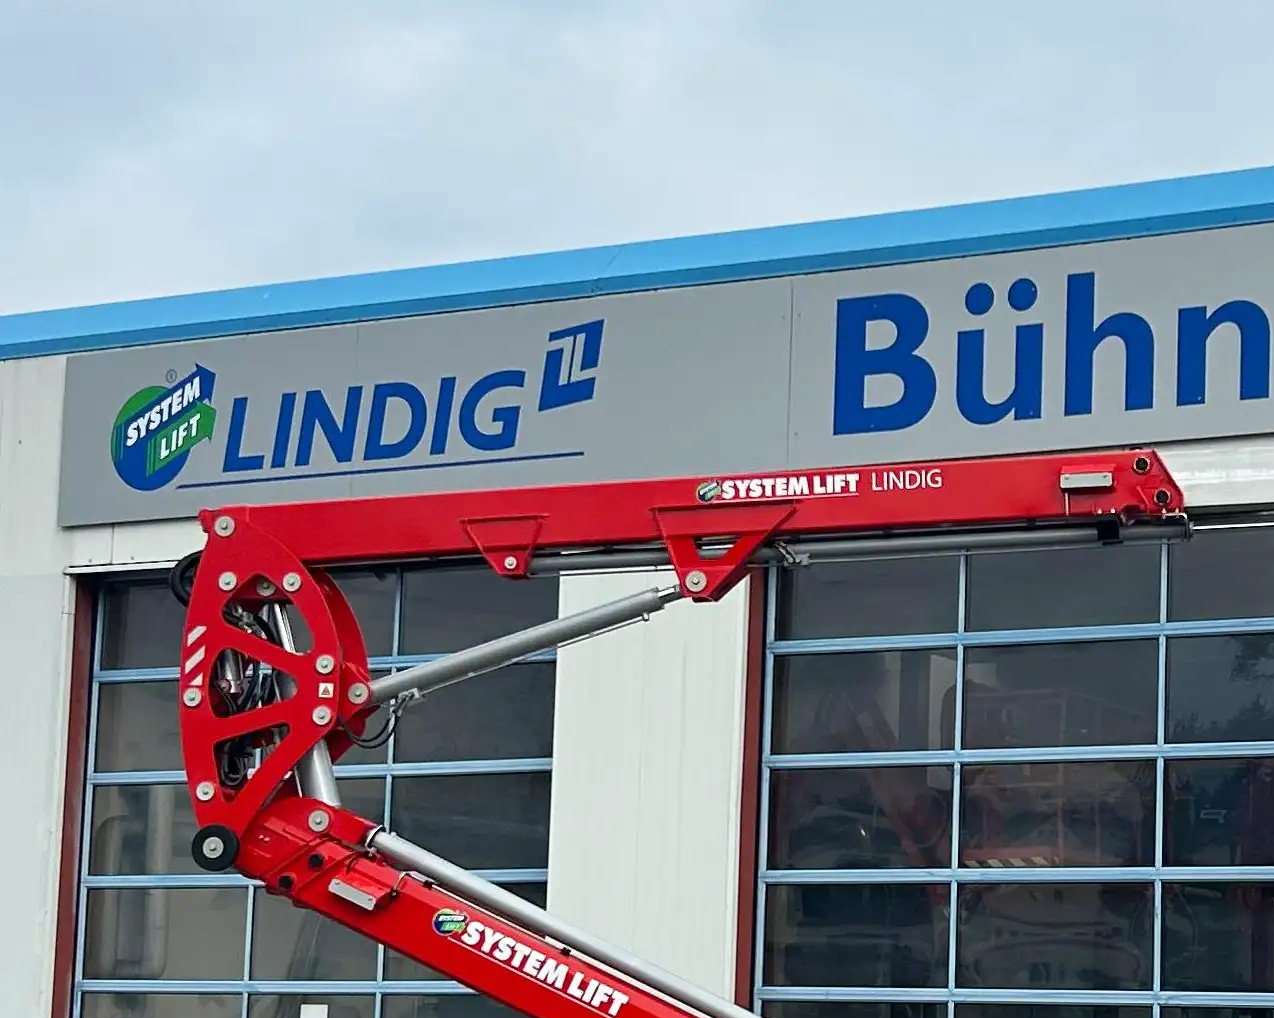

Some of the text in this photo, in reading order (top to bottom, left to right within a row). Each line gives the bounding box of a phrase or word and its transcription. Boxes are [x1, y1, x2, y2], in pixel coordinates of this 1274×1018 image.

[125, 375, 200, 446] SYSTEM
[160, 413, 201, 460] LIFT
[222, 369, 527, 473] LINDIG
[721, 476, 810, 500] SYSTEM
[812, 473, 860, 495] LIFT
[871, 468, 943, 492] LINDIG
[461, 921, 572, 990] SYSTEM
[565, 971, 631, 1016] LIFT
